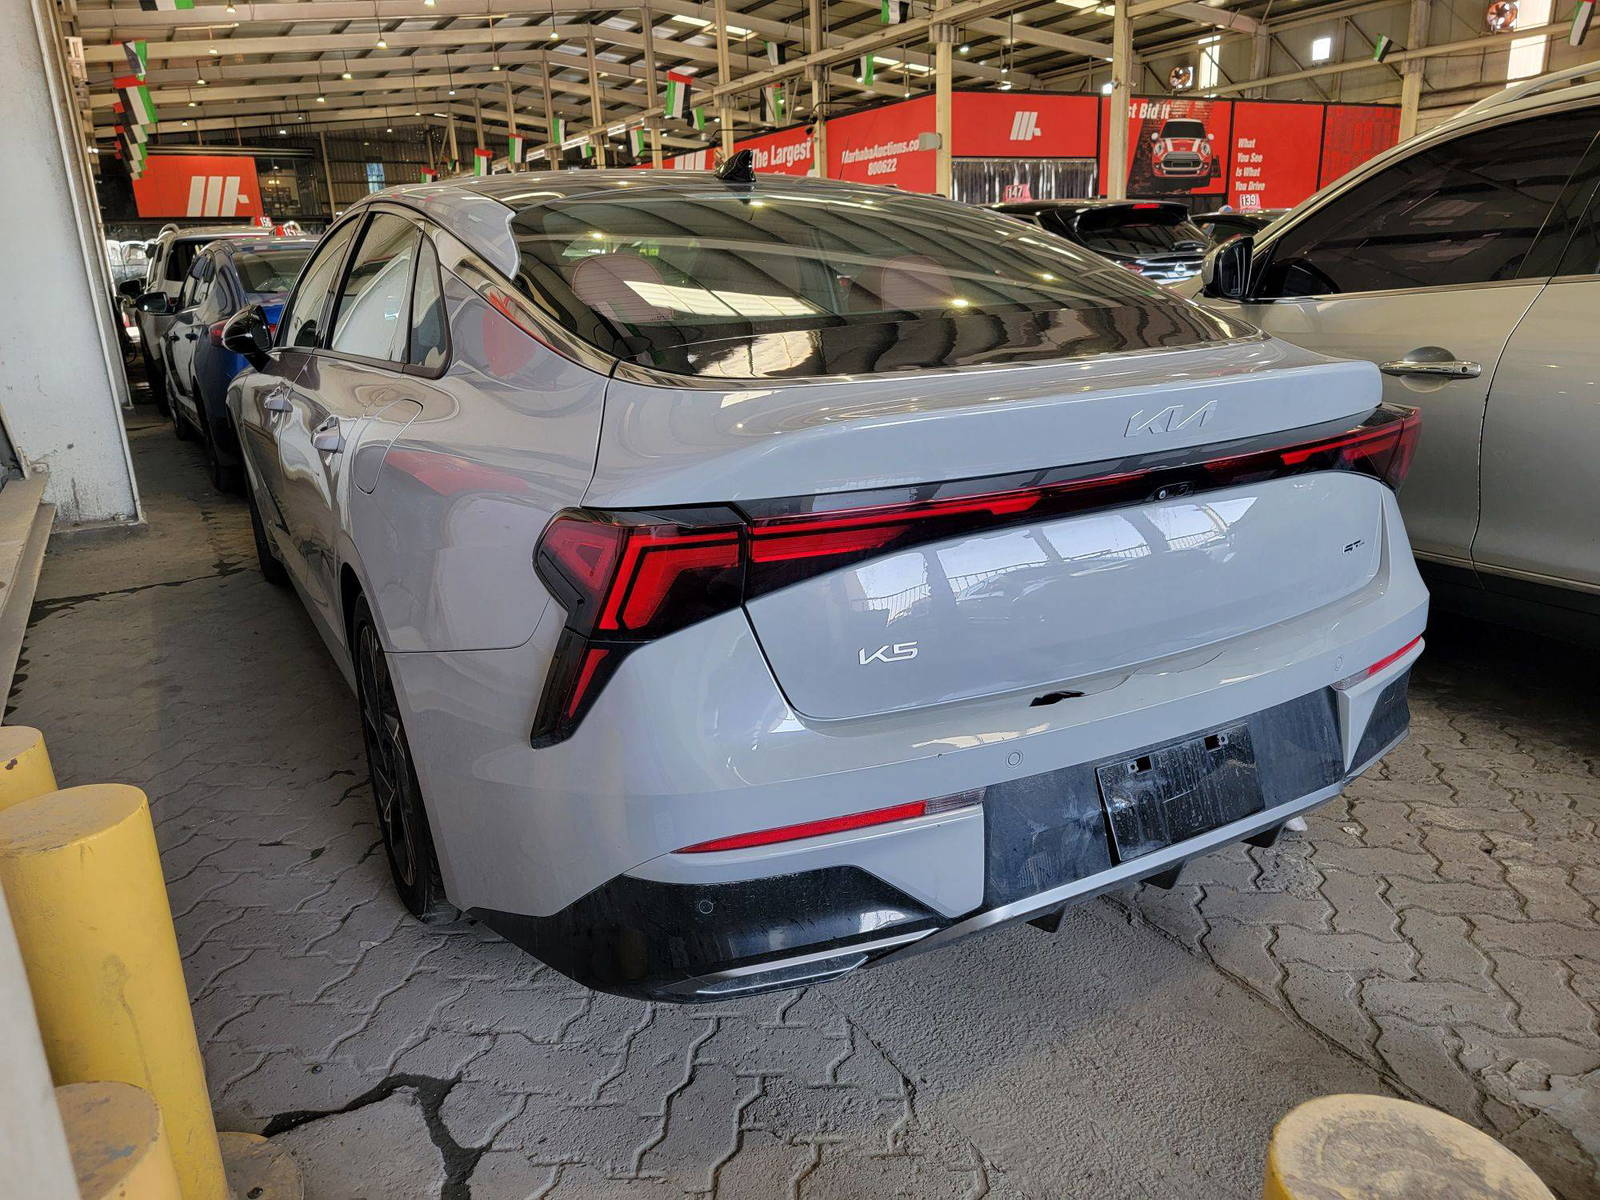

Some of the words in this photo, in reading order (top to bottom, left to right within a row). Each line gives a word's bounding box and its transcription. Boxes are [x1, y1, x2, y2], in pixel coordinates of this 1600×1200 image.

[1139, 103, 1159, 120] Bid
[1160, 103, 1171, 120] It
[1238, 138, 1256, 148] What
[752, 148, 769, 171] The
[771, 138, 811, 167] Largest
[841, 139, 920, 164] MarhabaAuctions.co
[1237, 152, 1250, 163] You
[1250, 152, 1263, 163] See
[1243, 166, 1261, 177] What
[1235, 181, 1248, 191] You
[1240, 194, 1257, 206] 139
[1123, 399, 1218, 438] KIA
[858, 640, 919, 665] K5
